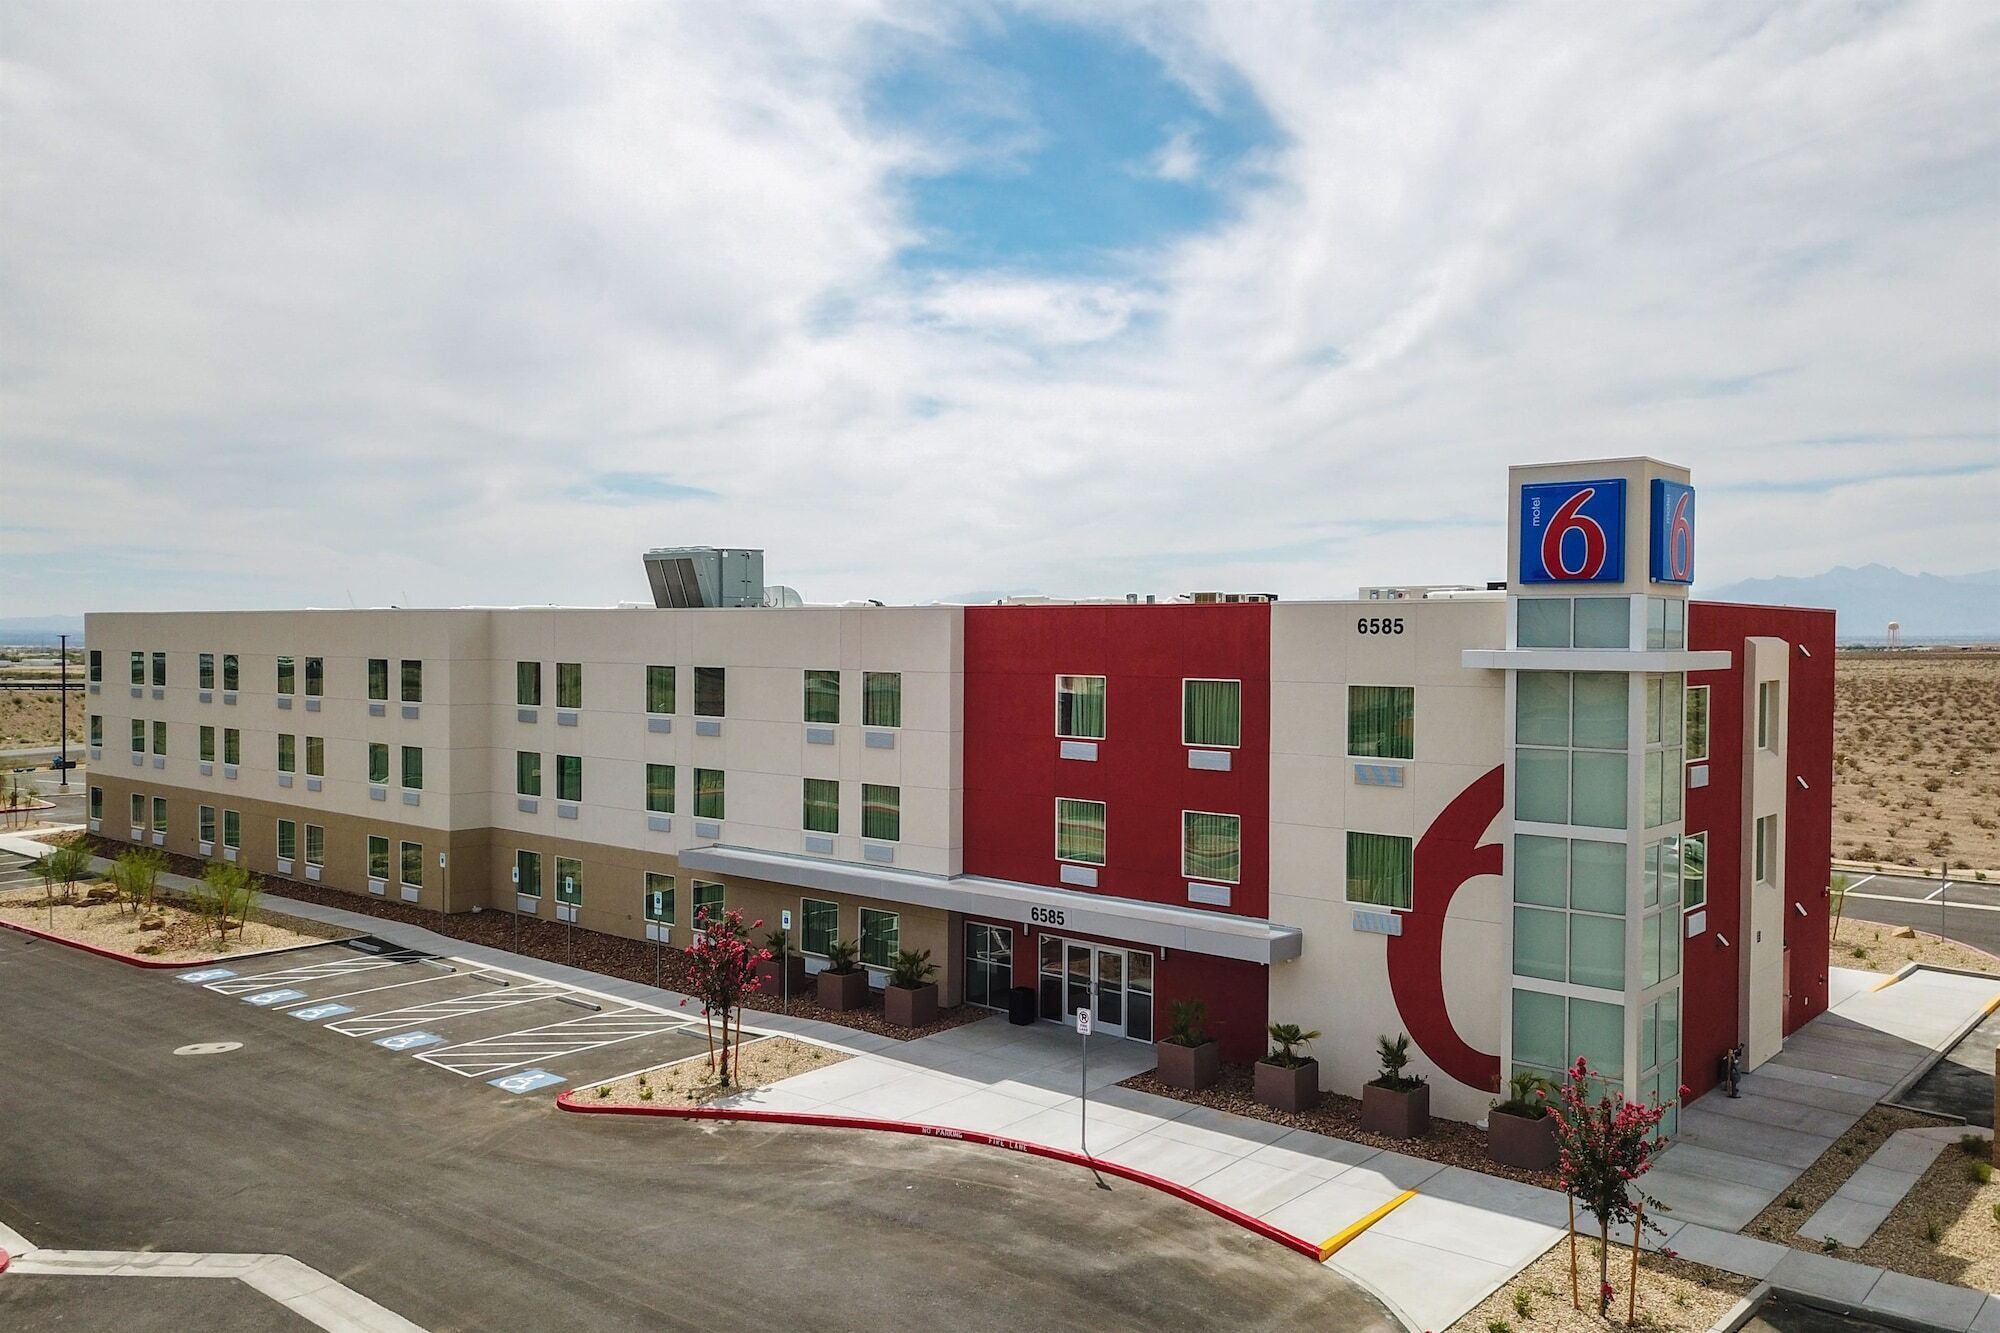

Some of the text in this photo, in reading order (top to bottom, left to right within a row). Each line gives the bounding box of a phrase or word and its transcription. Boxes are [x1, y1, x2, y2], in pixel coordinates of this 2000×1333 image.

[1531, 497, 1541, 527] motel
[1541, 488, 1607, 579] 6
[1670, 492, 1691, 580] 6
[1357, 618, 1404, 635] 6585
[1031, 906, 1065, 926] 6585
[935, 1129, 963, 1138] PARKING
[988, 1138, 1027, 1151] FIRE LANE
